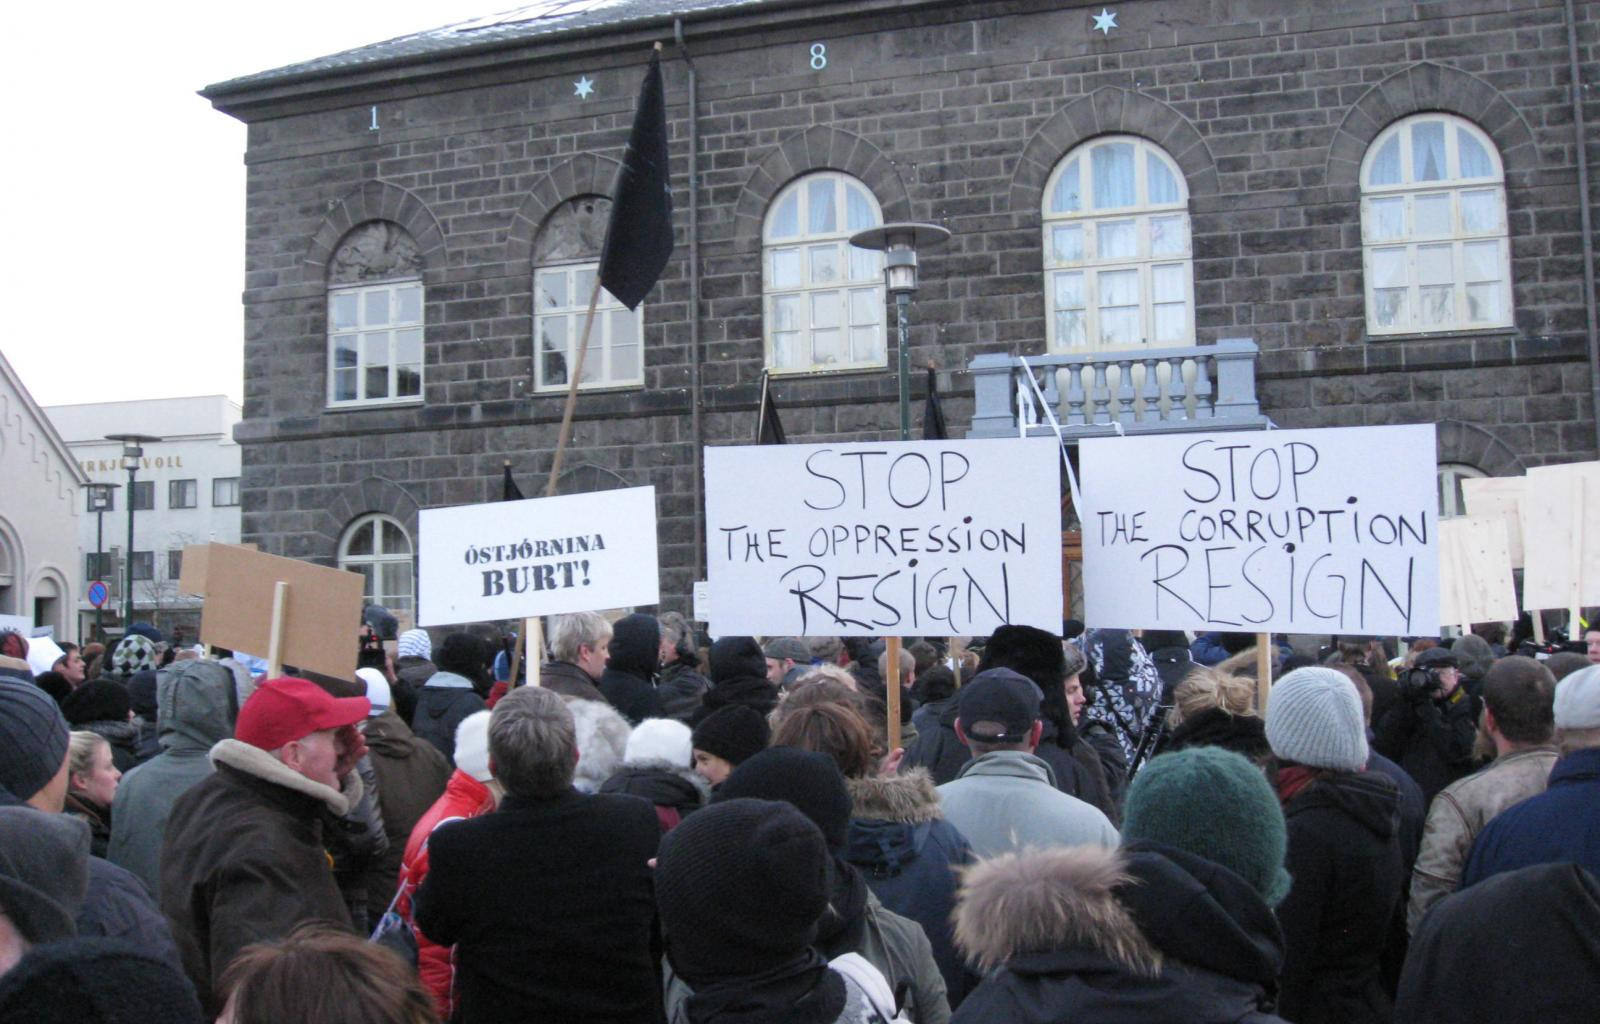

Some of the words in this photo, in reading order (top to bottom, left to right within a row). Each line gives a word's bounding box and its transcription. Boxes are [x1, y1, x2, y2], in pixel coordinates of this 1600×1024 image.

[810, 43, 827, 70] 8
[804, 449, 970, 511] STOP
[1182, 440, 1319, 503] STOP
[719, 525, 788, 562] THE
[1097, 510, 1149, 546] THE
[481, 559, 591, 597] BURT!
